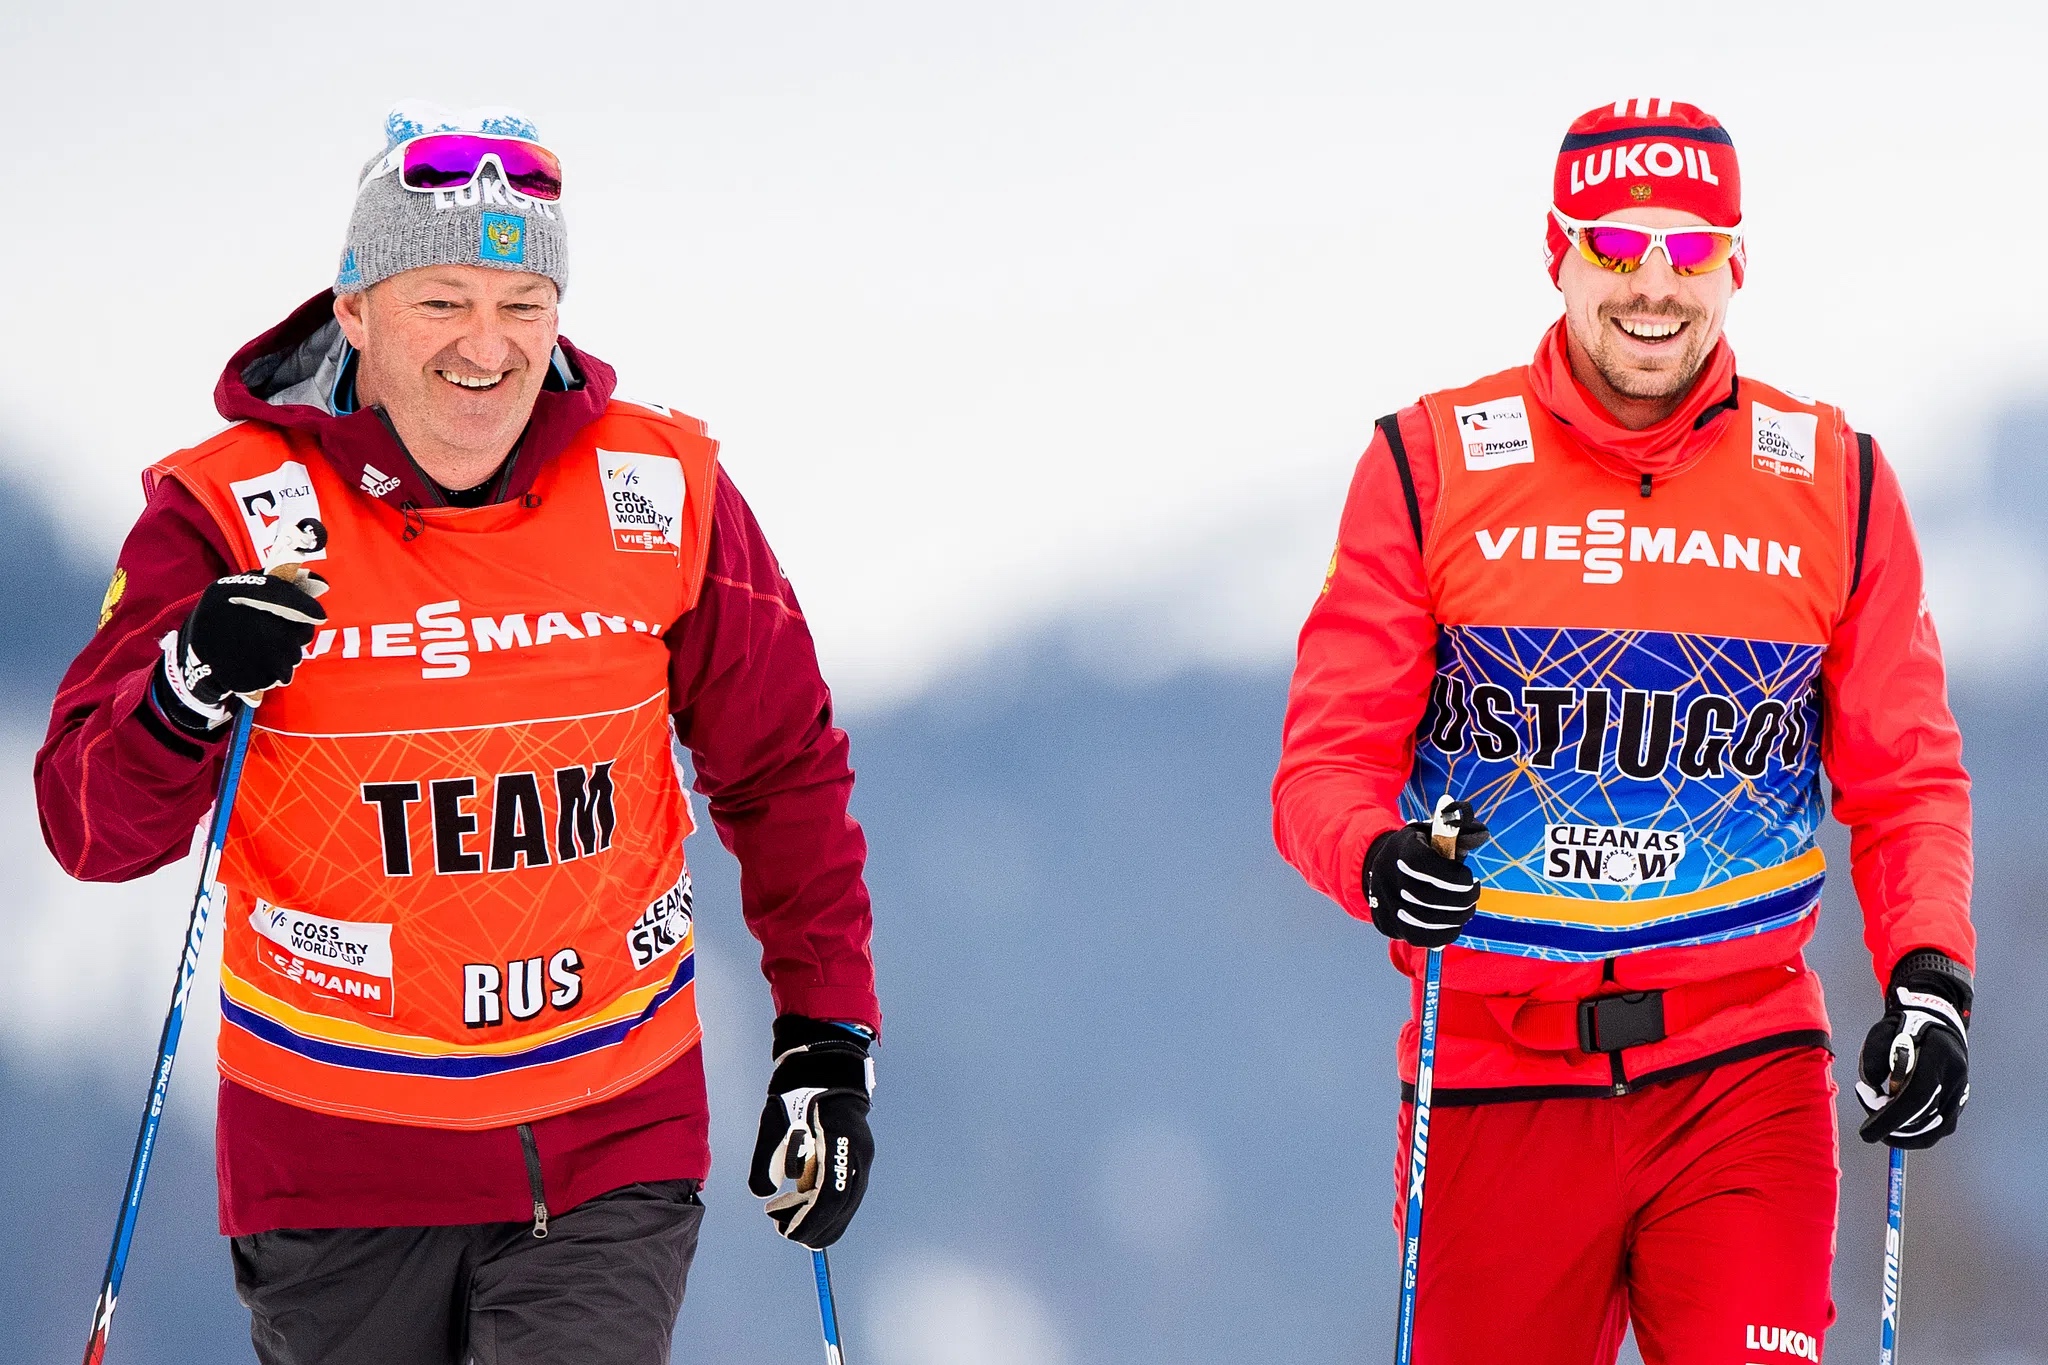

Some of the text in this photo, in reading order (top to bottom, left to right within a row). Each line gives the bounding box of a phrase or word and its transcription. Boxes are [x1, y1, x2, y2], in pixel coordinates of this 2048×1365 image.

[1571, 142, 1718, 195] LUKOIL
[1486, 440, 1528, 451] ЛУКОЙЛ
[616, 515, 655, 524] WORLD
[1475, 509, 1801, 584] VIESSMANN
[217, 574, 267, 585] adidas
[1430, 671, 1812, 781] USTIUGOV
[360, 758, 617, 877] TEAM
[1551, 826, 1679, 851] CLEAN AS
[1549, 848, 1680, 882] SNOW
[174, 842, 221, 1021] SWIX
[291, 935, 338, 958] WORLD
[463, 947, 583, 1029] RUS
[154, 1054, 174, 1093] TRIAC
[1409, 1061, 1433, 1209] SWIX
[835, 1137, 849, 1192] adidas
[1406, 1236, 1419, 1268] TRIAC
[1881, 1223, 1900, 1331] SWIX
[1746, 1324, 1819, 1363] LUKOIL
